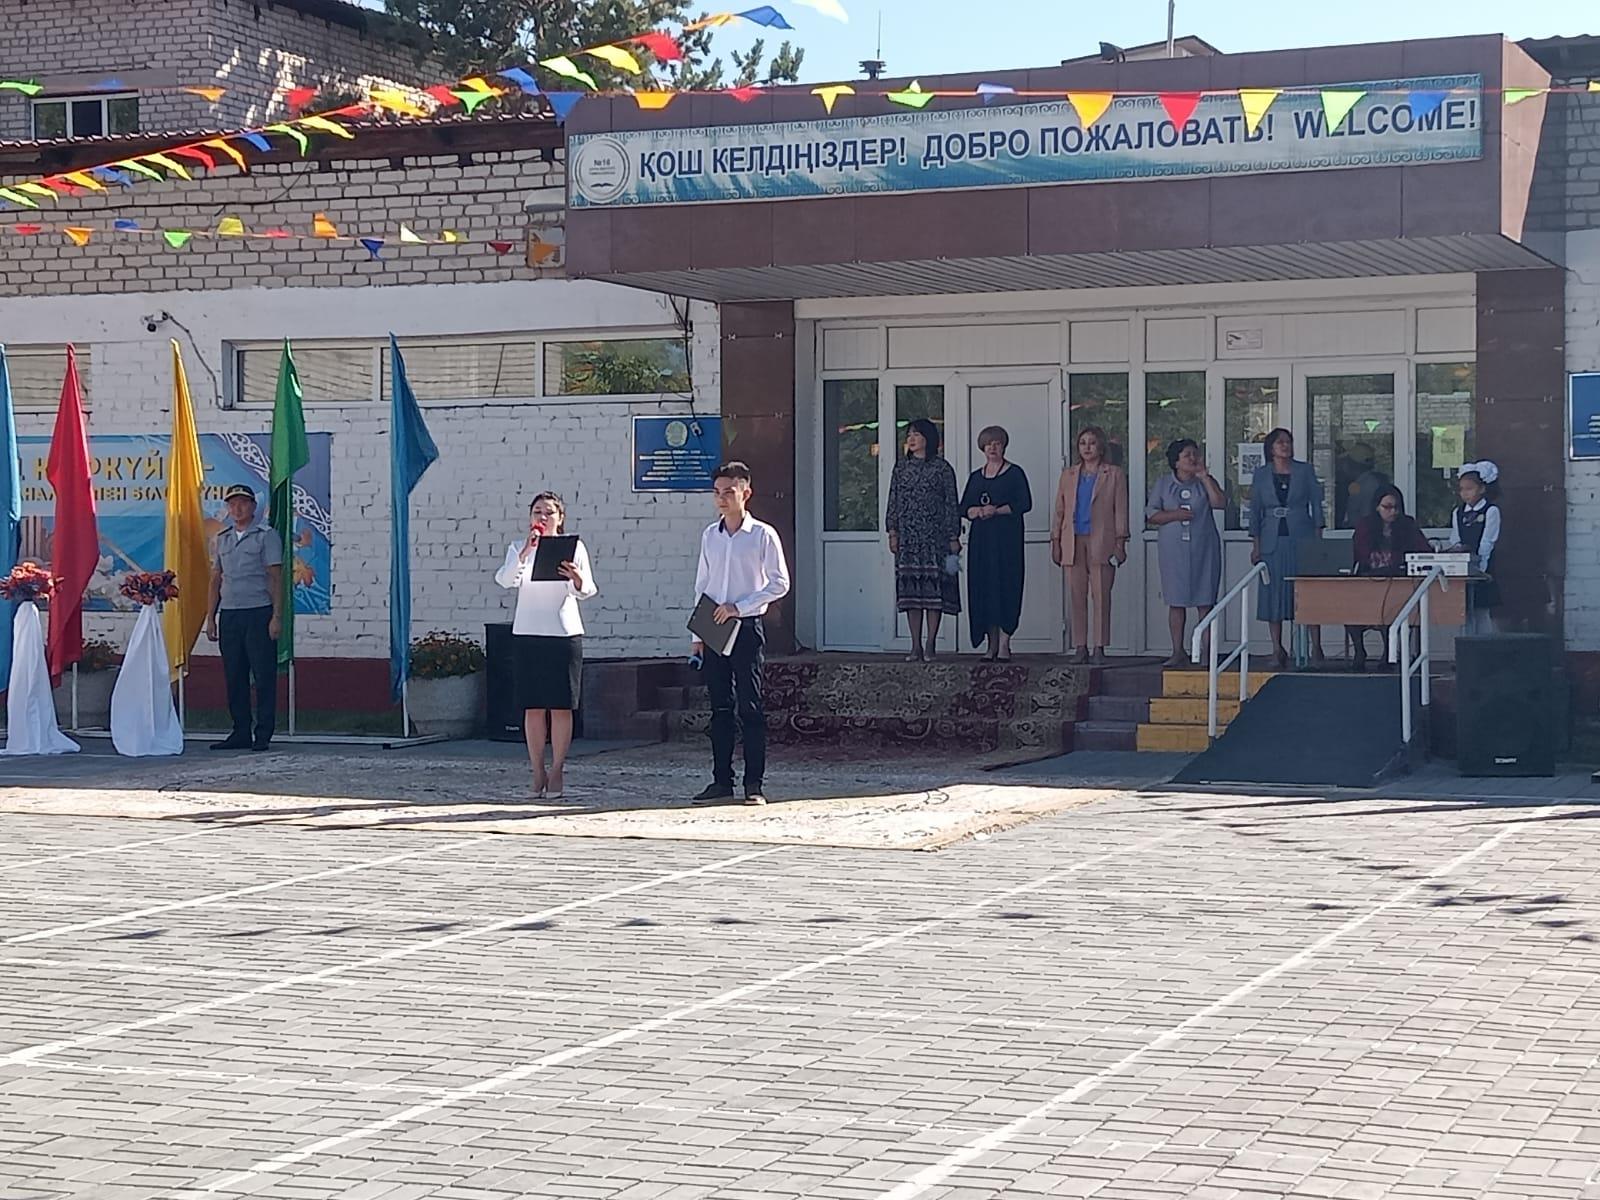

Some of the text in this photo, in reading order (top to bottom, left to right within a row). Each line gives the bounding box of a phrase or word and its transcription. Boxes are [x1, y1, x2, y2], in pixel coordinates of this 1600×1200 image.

[640, 149, 702, 182] ҚОШ
[712, 138, 906, 176] КЕЛДІҢІЗДЕР!
[922, 129, 1030, 167] ДОБРО
